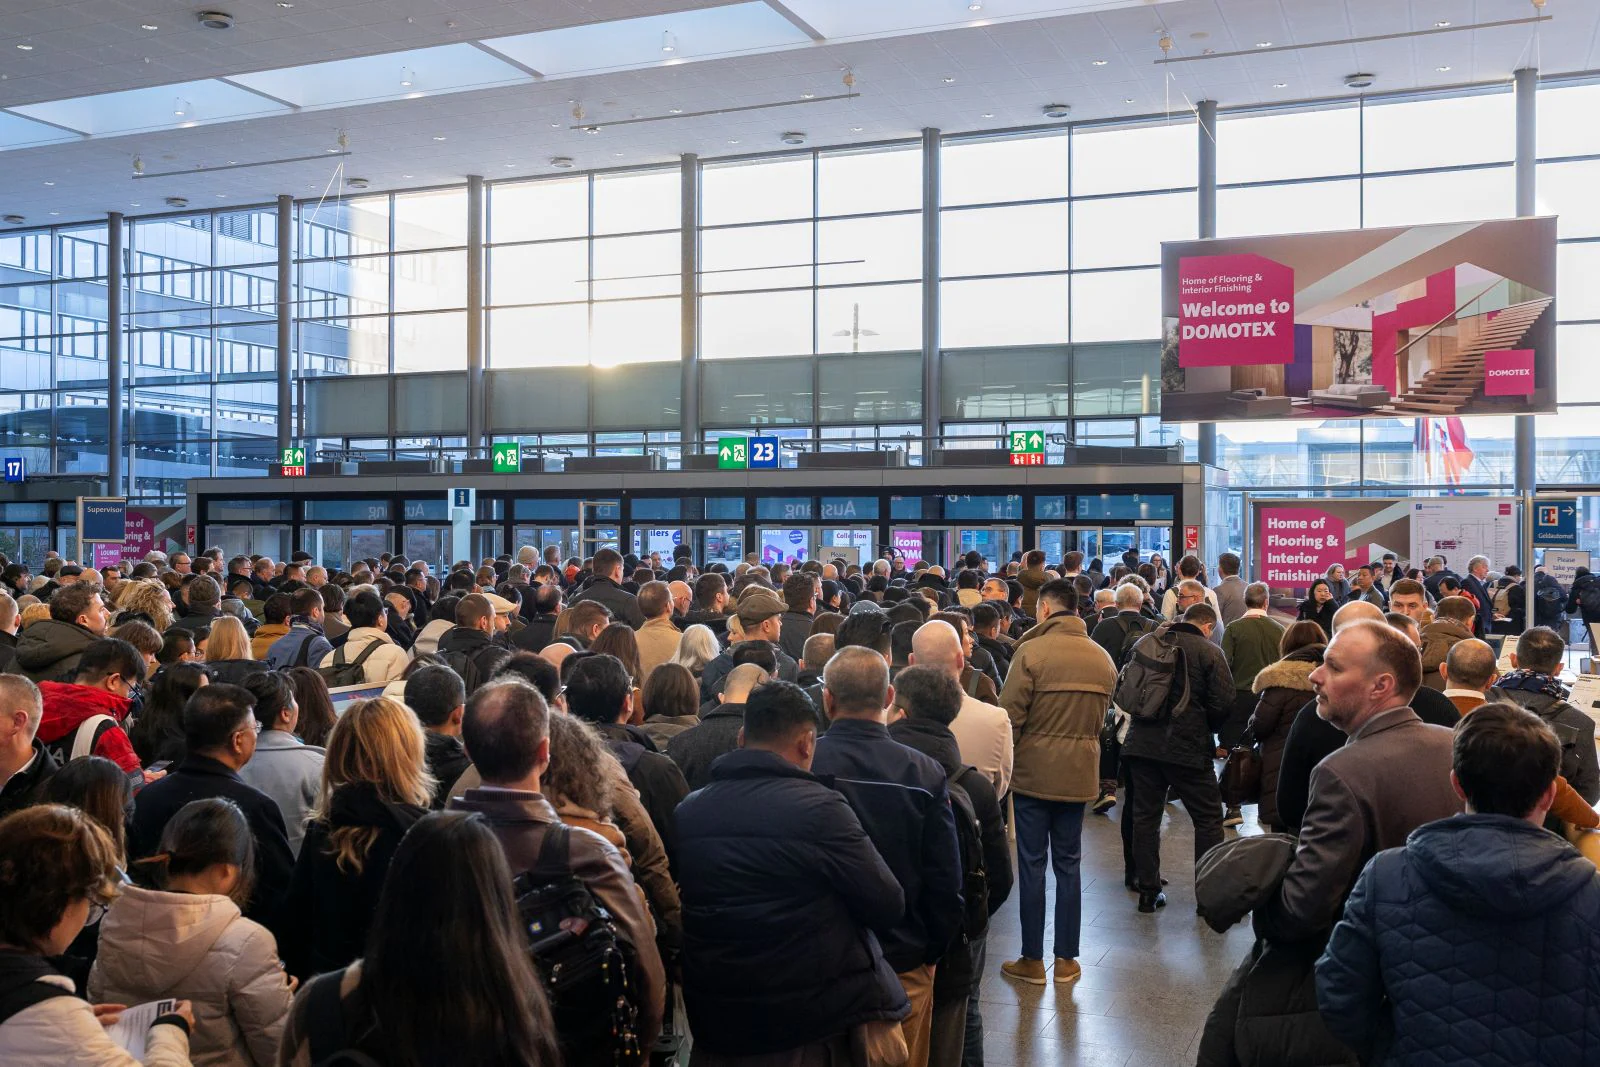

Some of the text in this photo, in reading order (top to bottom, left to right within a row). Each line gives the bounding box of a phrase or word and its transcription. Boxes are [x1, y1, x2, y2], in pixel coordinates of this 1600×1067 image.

[1182, 273, 1263, 286] Home of Flooring &
[1182, 283, 1252, 295] Interior Finishing
[1182, 298, 1290, 318] Welcome to
[1182, 321, 1277, 340] DOMOTEX
[1488, 368, 1530, 377] DOMOTEX
[753, 442, 774, 461] 23
[7, 462, 20, 476] 17
[87, 506, 123, 515] Supervisor
[135, 518, 144, 528] of
[1267, 516, 1326, 529] Home of
[143, 531, 151, 541] &
[1267, 534, 1339, 549] Flooring &
[120, 543, 141, 553] terior
[830, 551, 848, 559] Please
[1267, 551, 1319, 564] Interior
